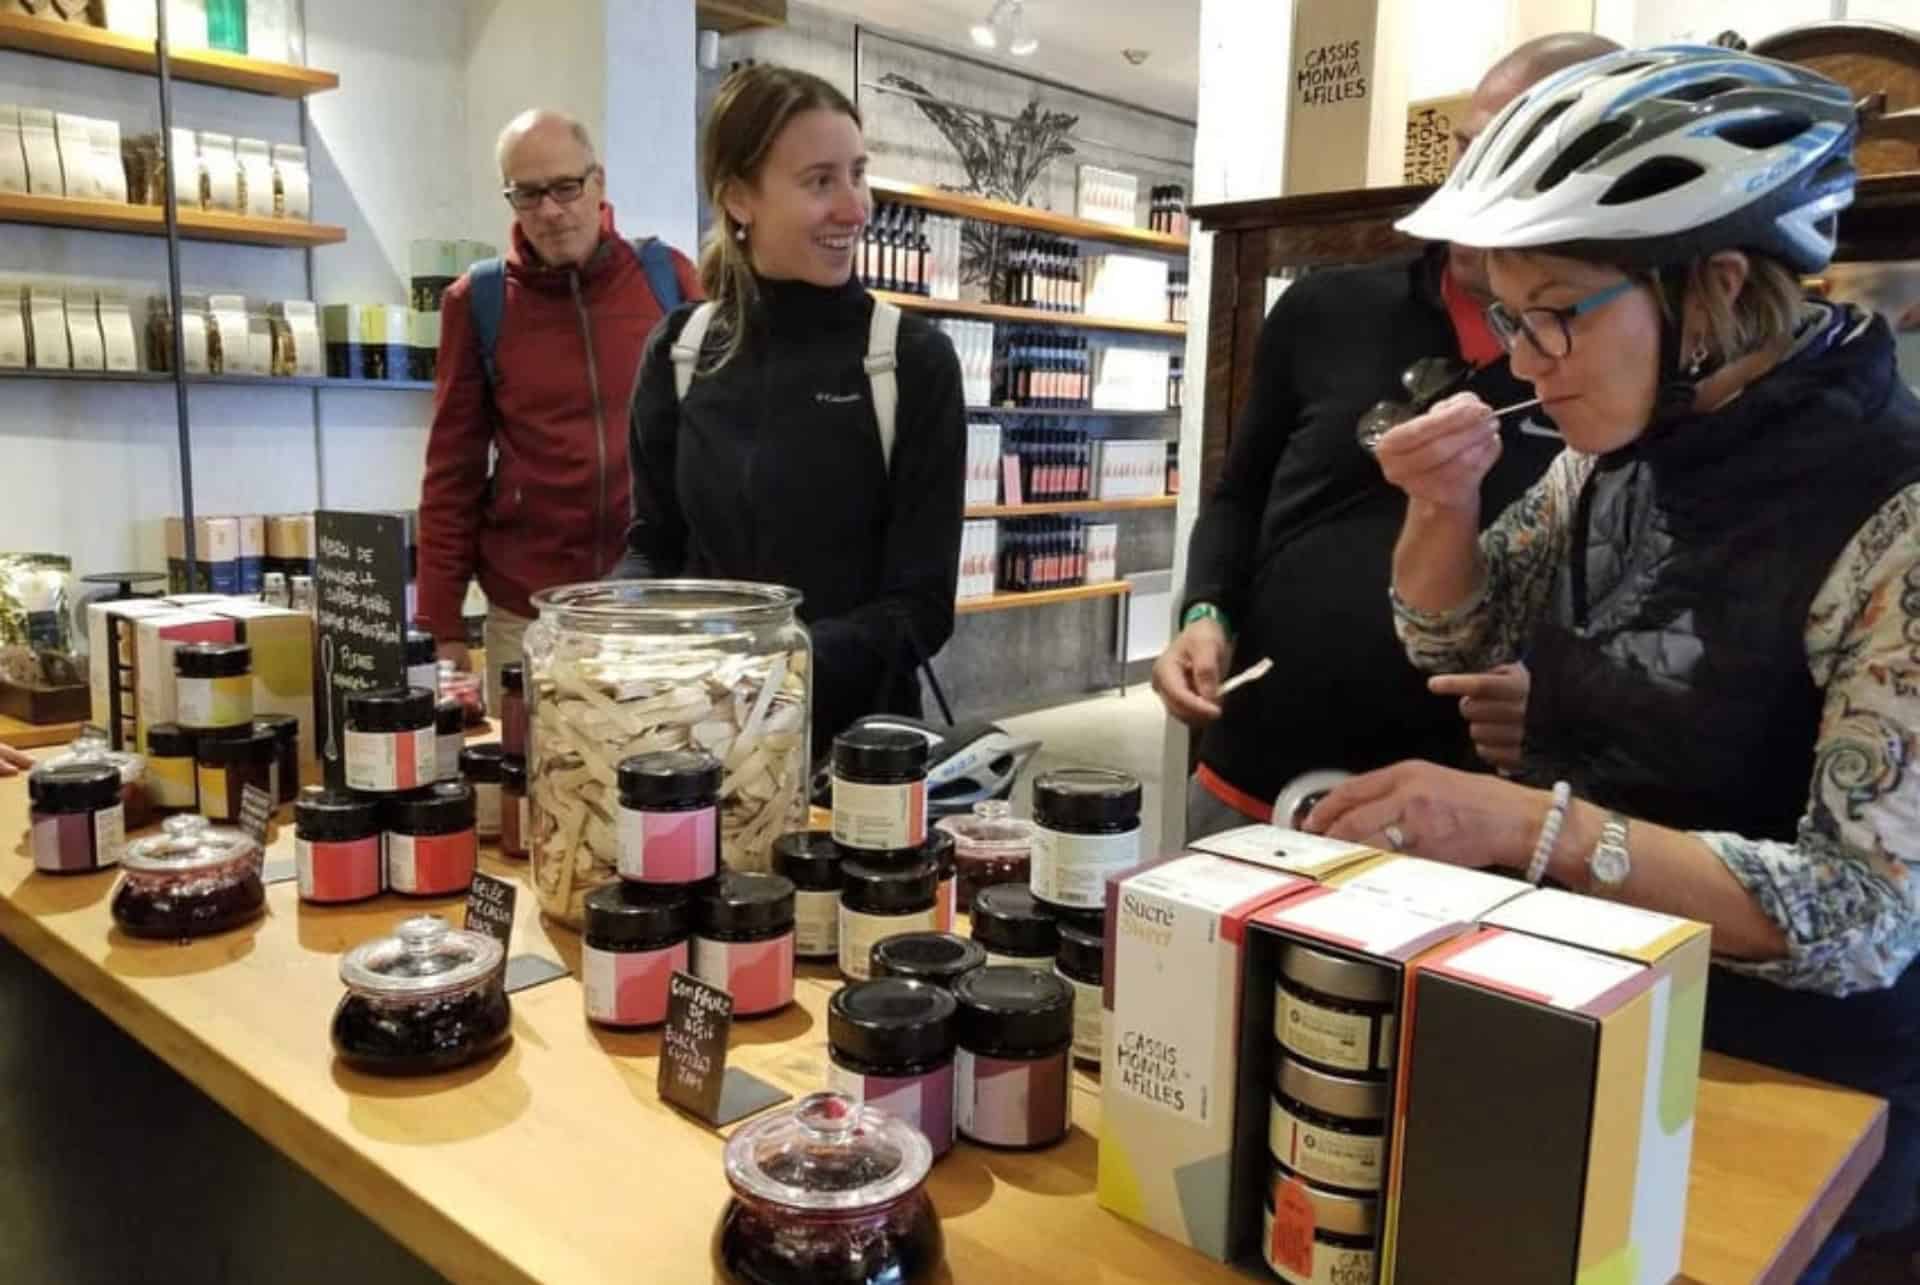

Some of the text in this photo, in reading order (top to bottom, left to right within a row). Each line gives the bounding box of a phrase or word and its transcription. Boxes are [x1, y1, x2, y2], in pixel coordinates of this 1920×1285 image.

[1304, 40, 1360, 69] CASSIS
[1297, 60, 1361, 91] MONNA
[1123, 893, 1175, 927] Sucré
[1123, 1031, 1177, 1066] CASSIS
